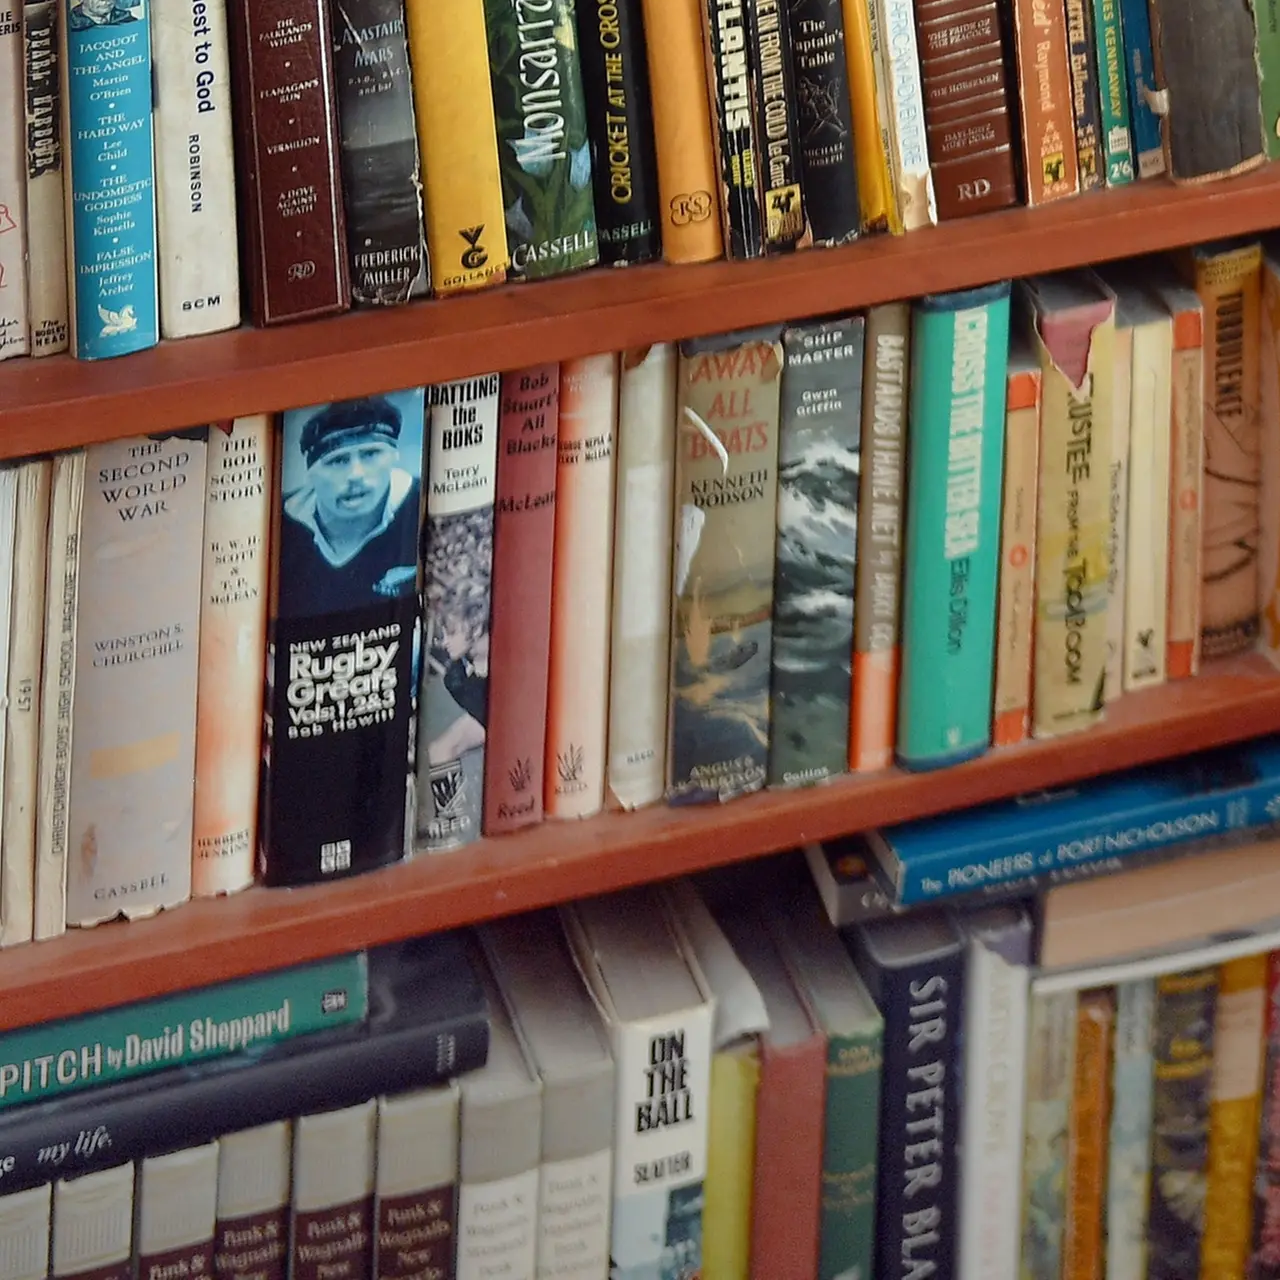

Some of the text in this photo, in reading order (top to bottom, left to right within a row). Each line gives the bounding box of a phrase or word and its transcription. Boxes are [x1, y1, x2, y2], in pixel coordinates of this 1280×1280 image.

[799, 20, 826, 34] The
[79, 33, 138, 54] JACQUOT
[95, 49, 125, 62] AND
[193, 40, 213, 65] to
[73, 55, 145, 76] THE ANGEL
[354, 46, 394, 68] MARS
[93, 74, 129, 88] Martin
[1036, 40, 1055, 112] Raymond
[1104, 26, 1122, 117] KENNAWAY
[90, 87, 132, 102] O'Brien
[195, 69, 216, 114] God
[606, 81, 627, 108] AT
[78, 118, 145, 140] HARD WAY
[97, 112, 126, 126] THE
[98, 148, 128, 162] Child
[606, 112, 634, 204] CRICKET
[100, 174, 128, 188] THE
[188, 134, 203, 214] ROBINSON
[74, 177, 152, 202] UNDOMESTIC
[957, 178, 992, 200] RD
[84, 192, 142, 213] GODDESS
[354, 245, 420, 269] FREDERICK
[511, 231, 594, 270] CASSELL
[362, 266, 411, 287] MULLER
[803, 331, 844, 348] SHIP
[690, 344, 775, 386] AWAY
[788, 344, 854, 367] MASTER
[427, 375, 498, 406] BATTLING
[518, 373, 549, 391] Bob
[872, 334, 905, 437] BASTARDS
[452, 403, 478, 426] the
[706, 389, 754, 419] ALL
[521, 413, 546, 433] All
[128, 440, 164, 459] THE
[221, 435, 258, 453] THE
[442, 425, 485, 451] BOKS
[98, 451, 190, 483] SECOND
[222, 452, 257, 470] BOB
[444, 463, 480, 480] Terry
[100, 473, 188, 504] WORLD
[209, 466, 266, 486] SCOTT
[432, 475, 489, 497] McLean
[691, 469, 769, 494] KENNETH
[209, 481, 266, 503] STORY
[693, 485, 765, 508] DODSON
[118, 499, 169, 522] WAR
[93, 626, 171, 653] WINSTON
[288, 623, 402, 654] NEW ZEALAND
[92, 640, 184, 668] CHURCHILL
[288, 638, 401, 680] Rugby
[287, 666, 399, 708] Greats
[947, 852, 1034, 889] PIONEERS
[1102, 810, 1220, 851] NICHOLSON
[93, 872, 170, 901] CASSELL
[0, 999, 291, 1098] PITCH by David Sheppard
[650, 1030, 685, 1065] ON
[645, 1061, 688, 1096] THE
[904, 976, 948, 1200] SIR PETER
[636, 1089, 694, 1134] BALL
[37, 1140, 69, 1166] my
[633, 1151, 692, 1185] SLATTER
[387, 1204, 422, 1227] Funk
